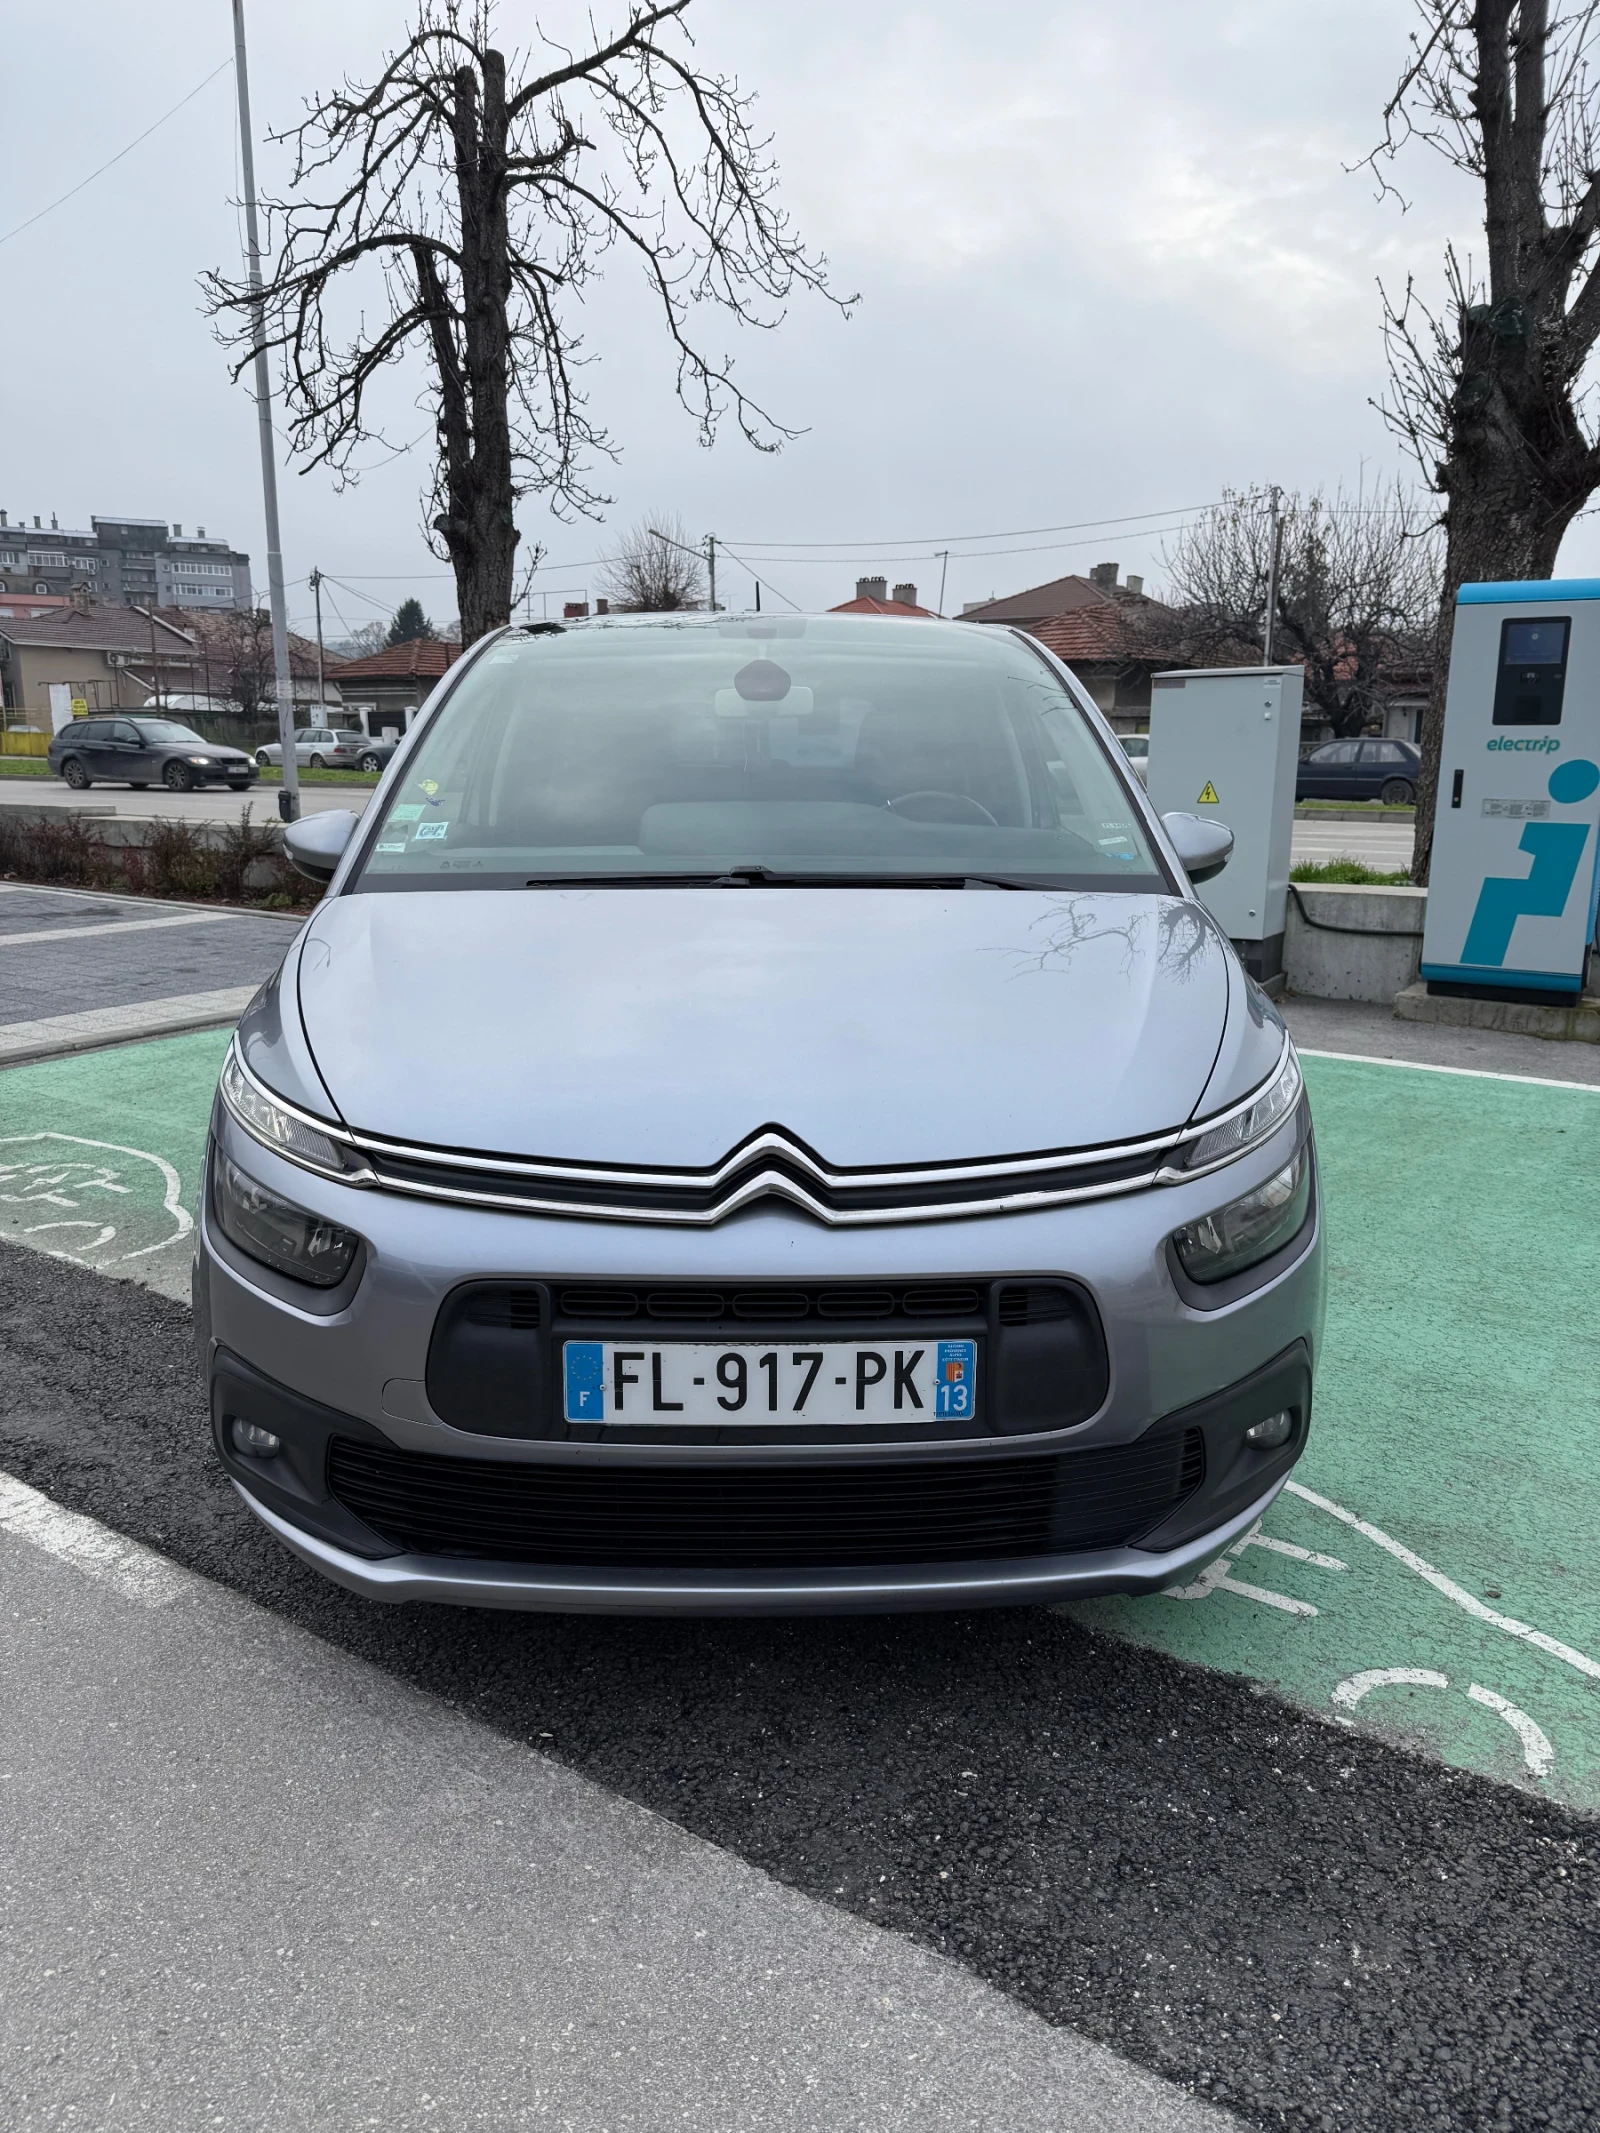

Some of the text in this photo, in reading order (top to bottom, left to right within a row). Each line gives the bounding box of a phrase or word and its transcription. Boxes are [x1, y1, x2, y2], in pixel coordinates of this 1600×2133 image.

[1486, 735, 1561, 755] electrip
[613, 1350, 925, 1411] FL-917-PK
[579, 1390, 591, 1407] F
[940, 1384, 968, 1411] 13
